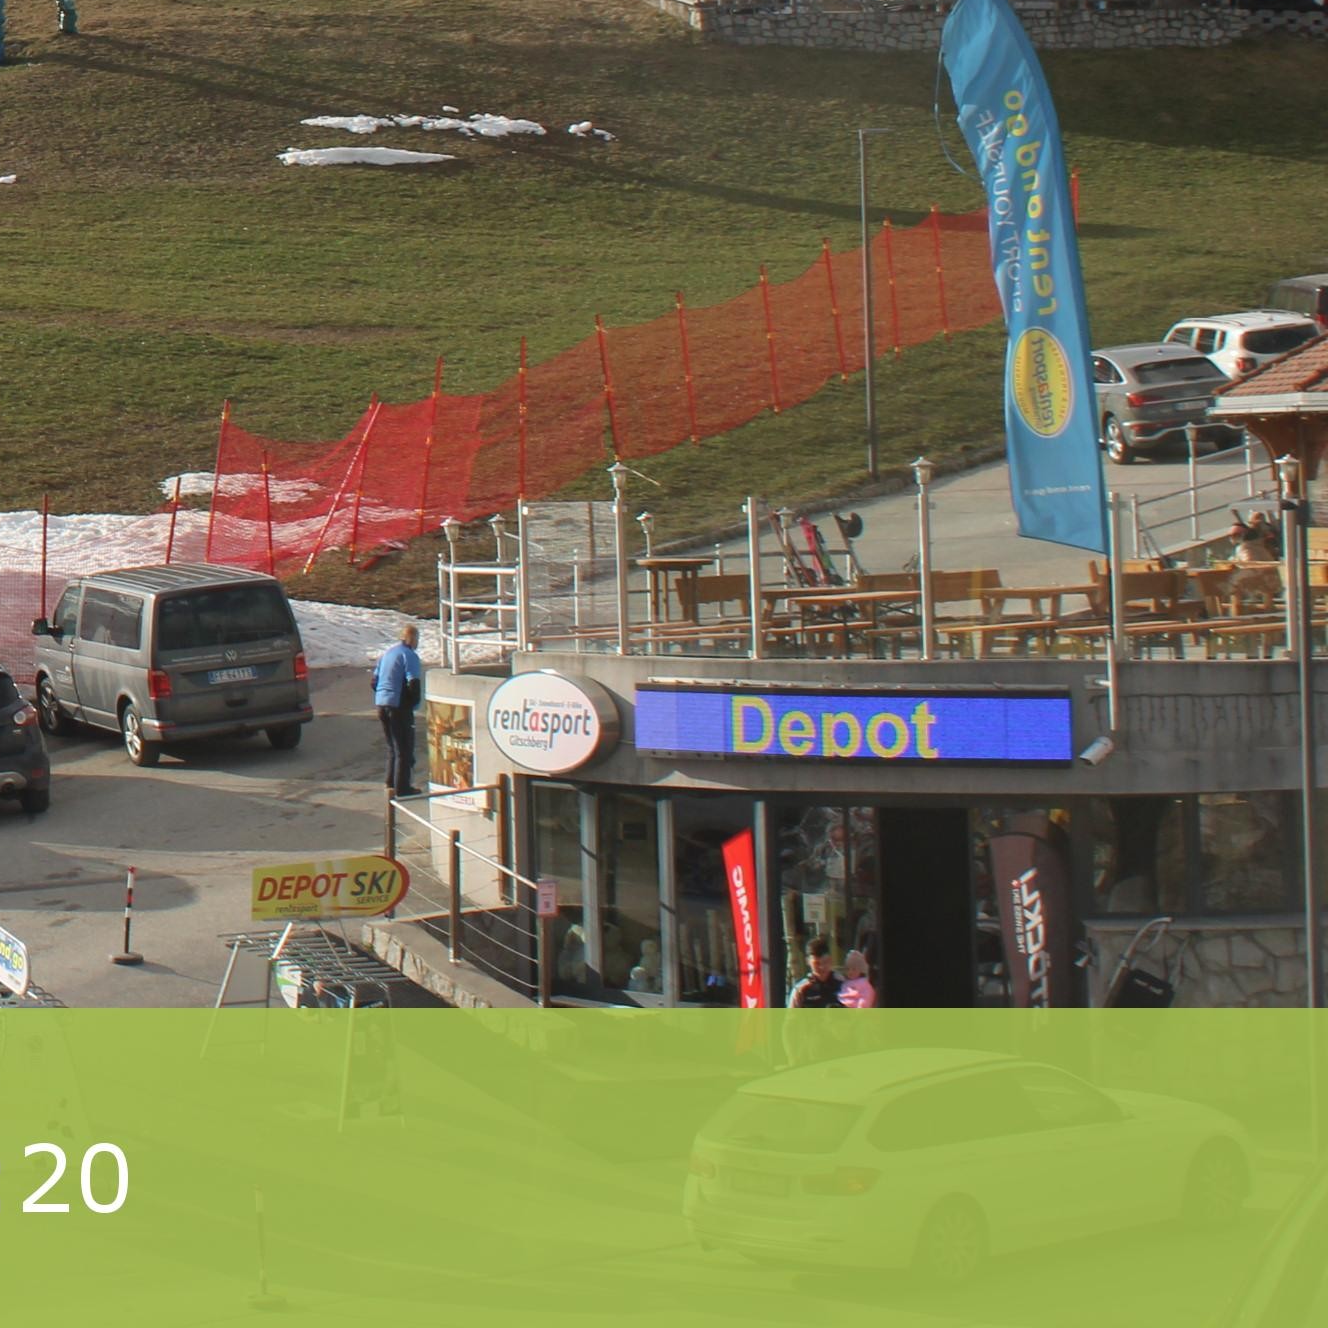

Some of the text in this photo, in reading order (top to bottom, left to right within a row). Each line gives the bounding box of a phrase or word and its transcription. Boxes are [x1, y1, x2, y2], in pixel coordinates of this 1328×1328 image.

[493, 698, 591, 749] rentasport
[731, 695, 939, 759] Depot
[257, 869, 397, 902] DEPOT SKI
[11, 952, 24, 970] go
